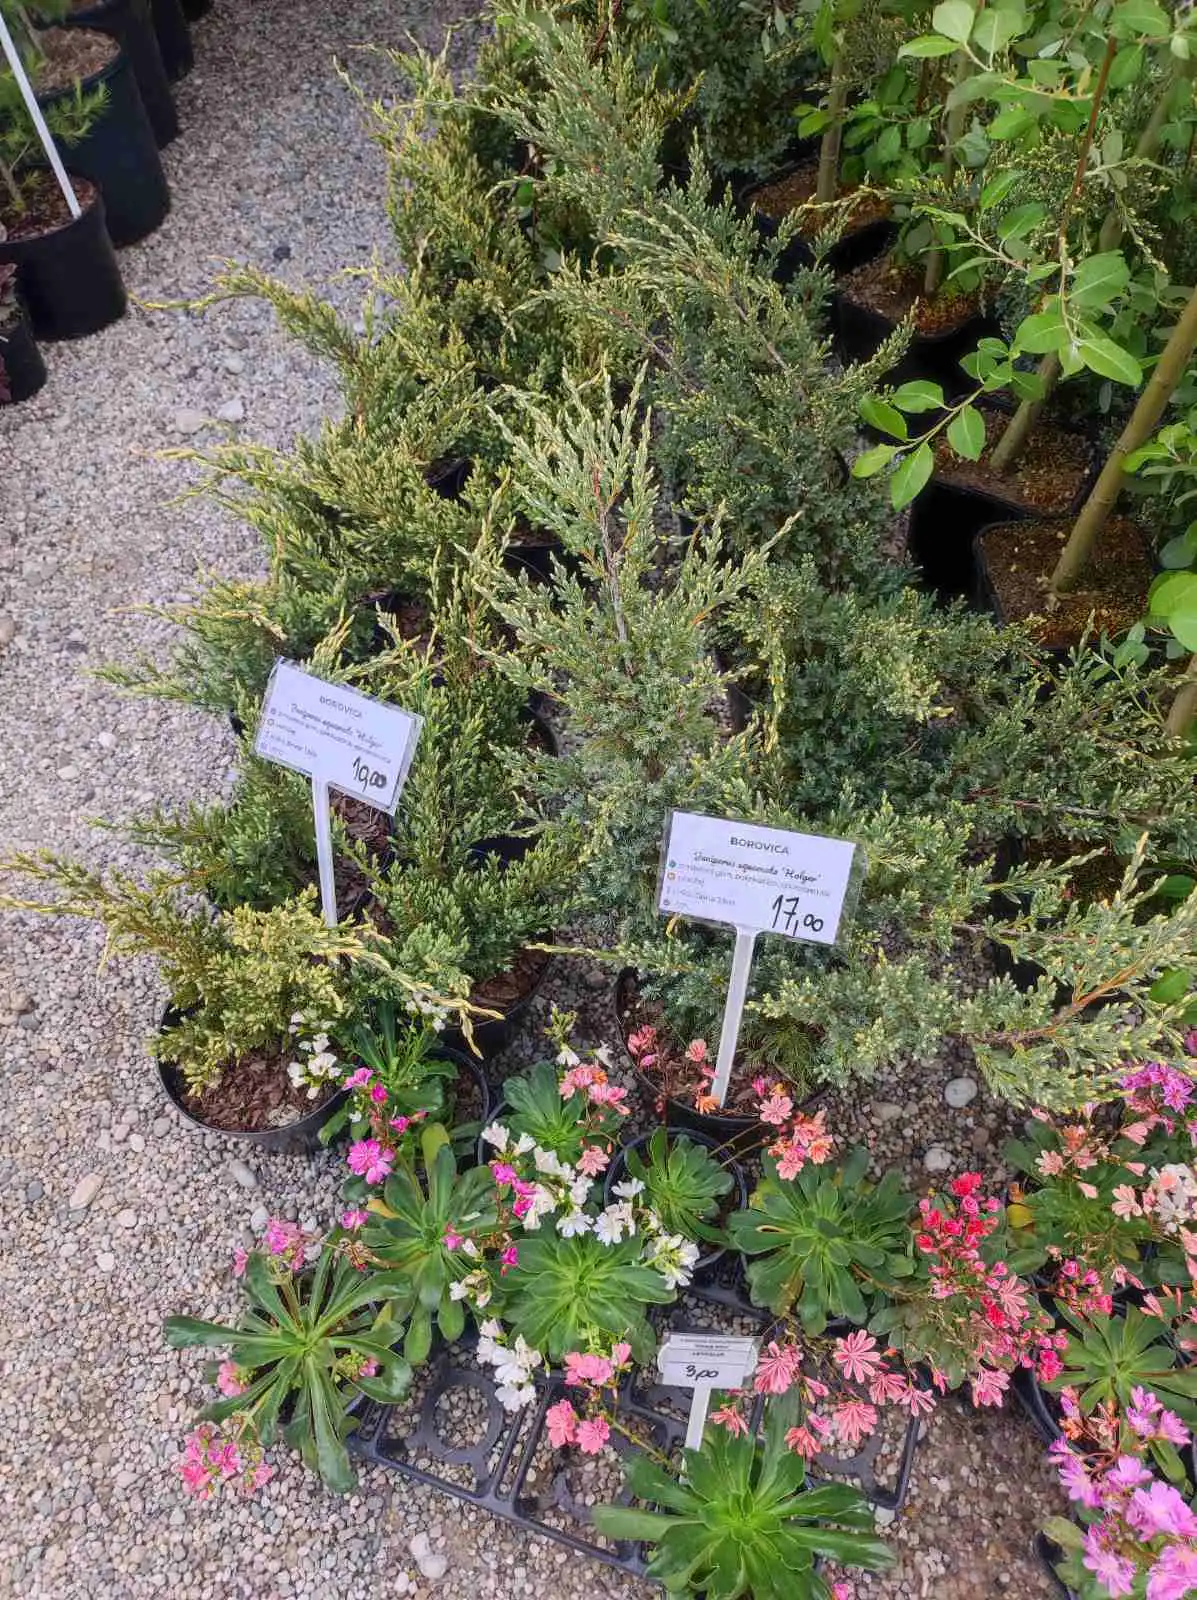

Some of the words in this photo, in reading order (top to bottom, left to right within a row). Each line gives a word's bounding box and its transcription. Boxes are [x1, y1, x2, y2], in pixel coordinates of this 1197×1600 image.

[730, 837, 790, 855] BOROVICA
[772, 894, 824, 937] 17,00
[685, 1364, 719, 1381] 3,00
